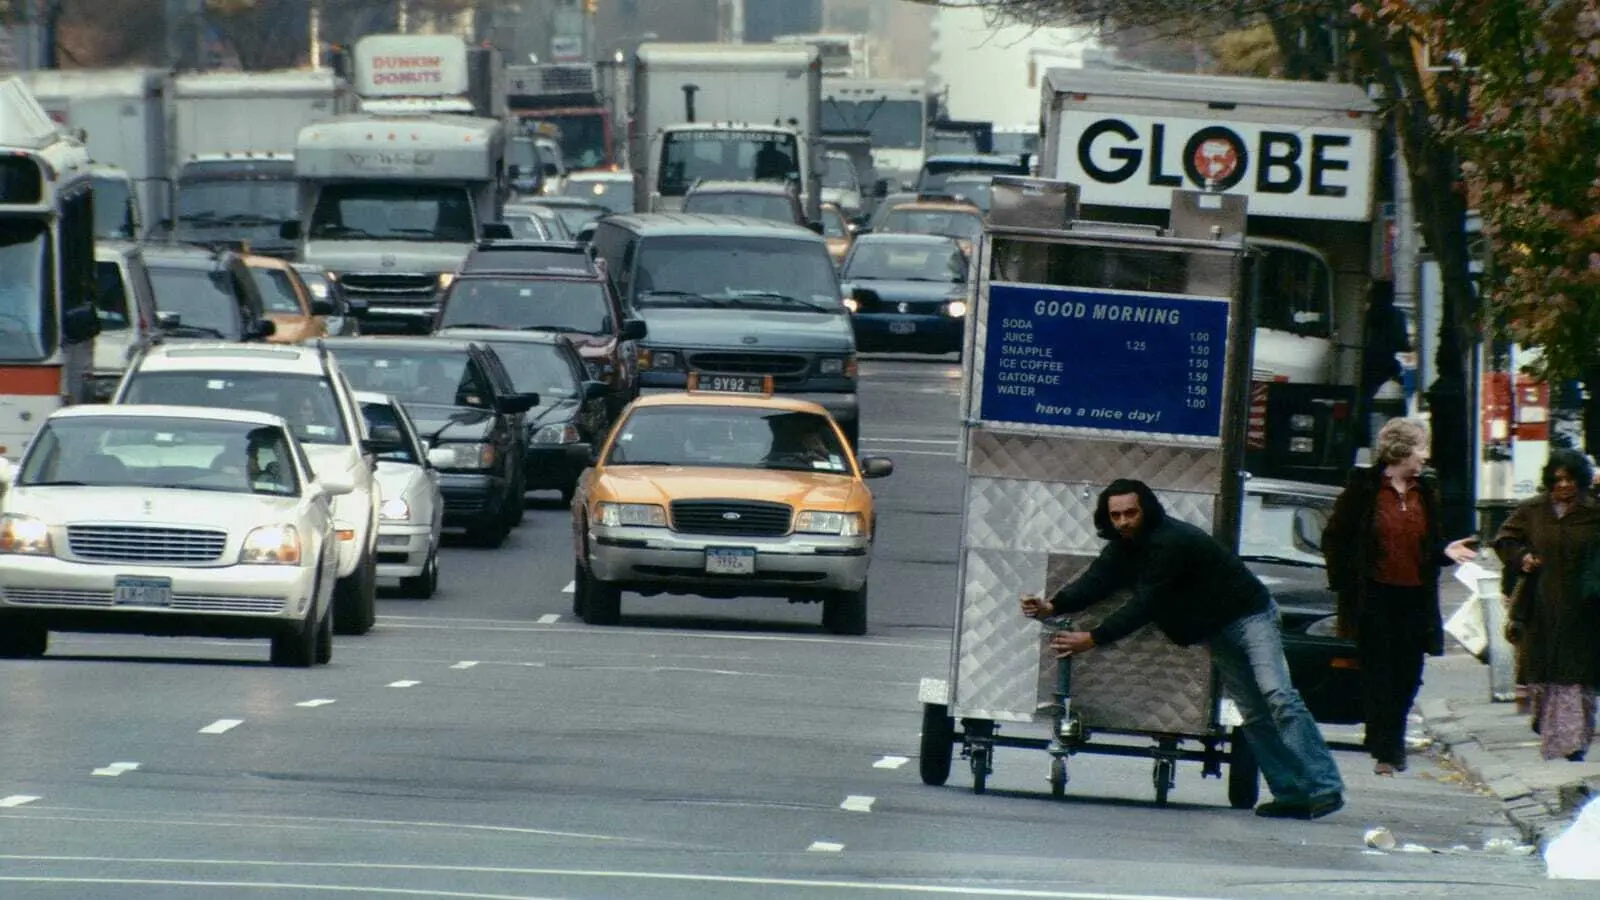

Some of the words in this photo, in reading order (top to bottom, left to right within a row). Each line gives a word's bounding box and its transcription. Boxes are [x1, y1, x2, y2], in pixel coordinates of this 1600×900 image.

[1077, 118, 1351, 197] GLOBE
[1034, 299, 1086, 318] GOOD
[1092, 304, 1181, 325] MORNING
[1001, 318, 1033, 330] SODA
[1190, 332, 1209, 342] 1.00
[1001, 345, 1053, 358] SNAPPLE
[1002, 331, 1034, 343] JUICE
[1126, 340, 1146, 350] 1.25
[1190, 345, 1210, 356] 1.50
[999, 358, 1017, 369] ICE
[1020, 359, 1064, 372] COFFEE
[1188, 371, 1208, 382] 1.50
[713, 377, 745, 391] 9Y92
[998, 372, 1061, 385] GATORADE
[1187, 385, 1208, 396] 1.50
[997, 385, 1036, 397] WATER
[1186, 398, 1206, 409] 1.00
[1035, 402, 1072, 416] have
[1076, 406, 1086, 417] a
[1090, 407, 1123, 420] nice
[1127, 410, 1162, 424] day!
